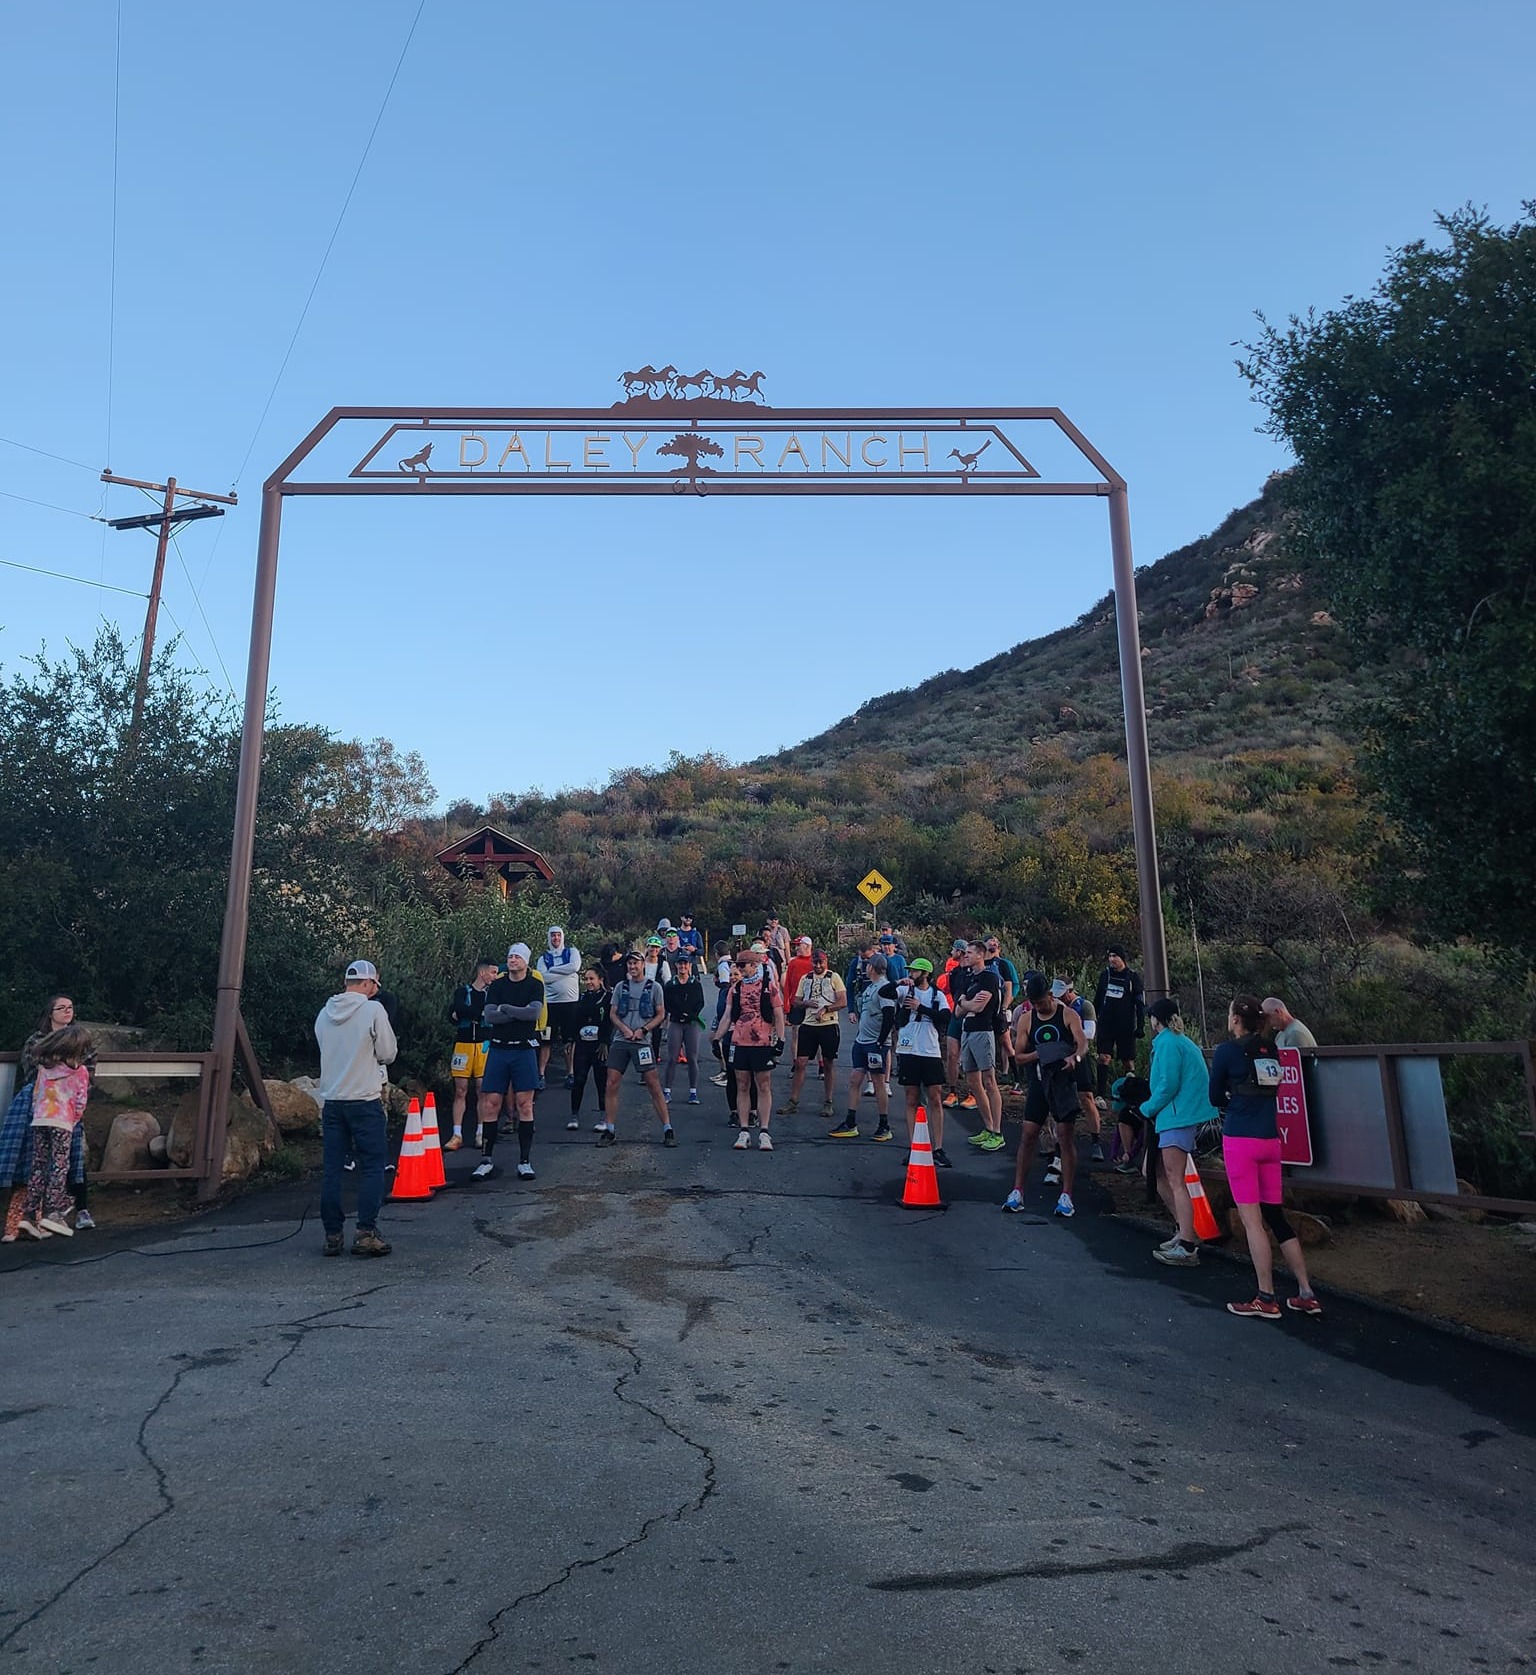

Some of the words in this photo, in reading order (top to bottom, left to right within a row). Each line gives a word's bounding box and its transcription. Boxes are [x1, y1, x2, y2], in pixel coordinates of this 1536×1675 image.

[460, 435, 648, 467] DALEY
[734, 435, 929, 467] RANCH
[1266, 1066, 1278, 1077] 13
